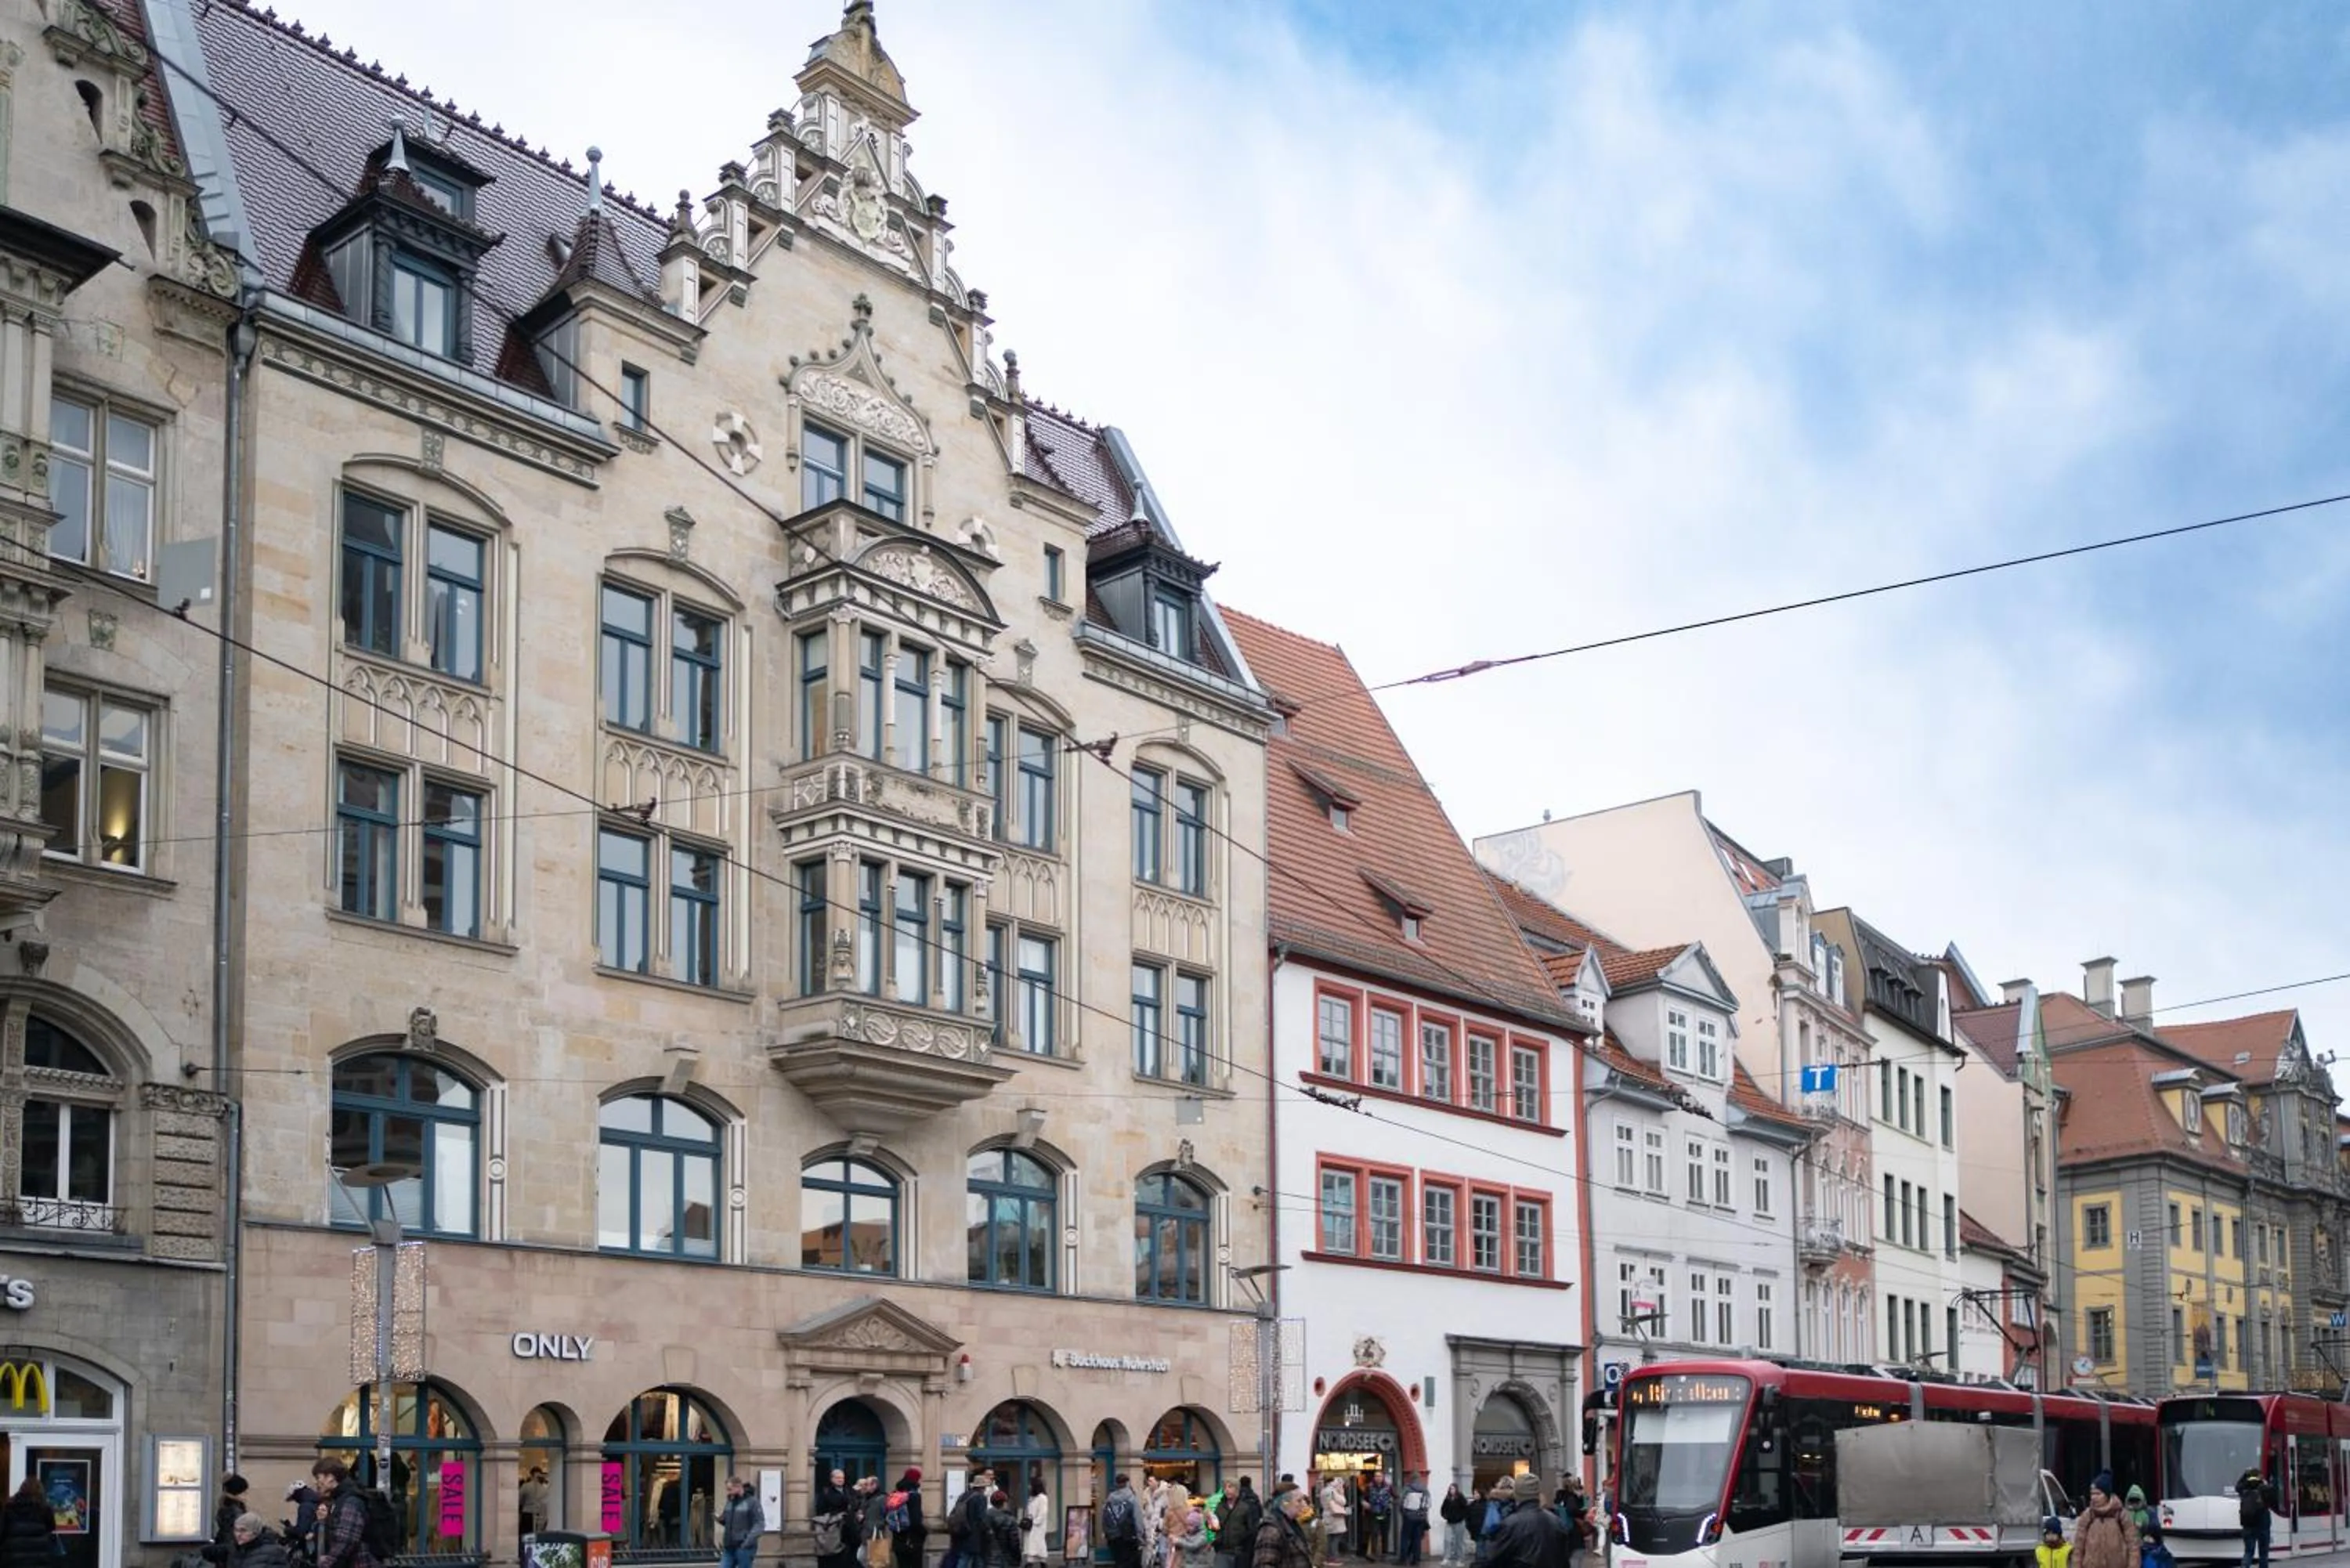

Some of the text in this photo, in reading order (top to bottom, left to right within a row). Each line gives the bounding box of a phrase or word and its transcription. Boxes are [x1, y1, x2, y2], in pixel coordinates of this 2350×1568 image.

[1809, 1067, 1829, 1089] T
[512, 1332, 594, 1360] ONLY
[1319, 1432, 1377, 1451] NORDSEE
[442, 1474, 464, 1523] SALE
[602, 1473, 620, 1521] SALE
[1911, 1525, 1923, 1542] A
